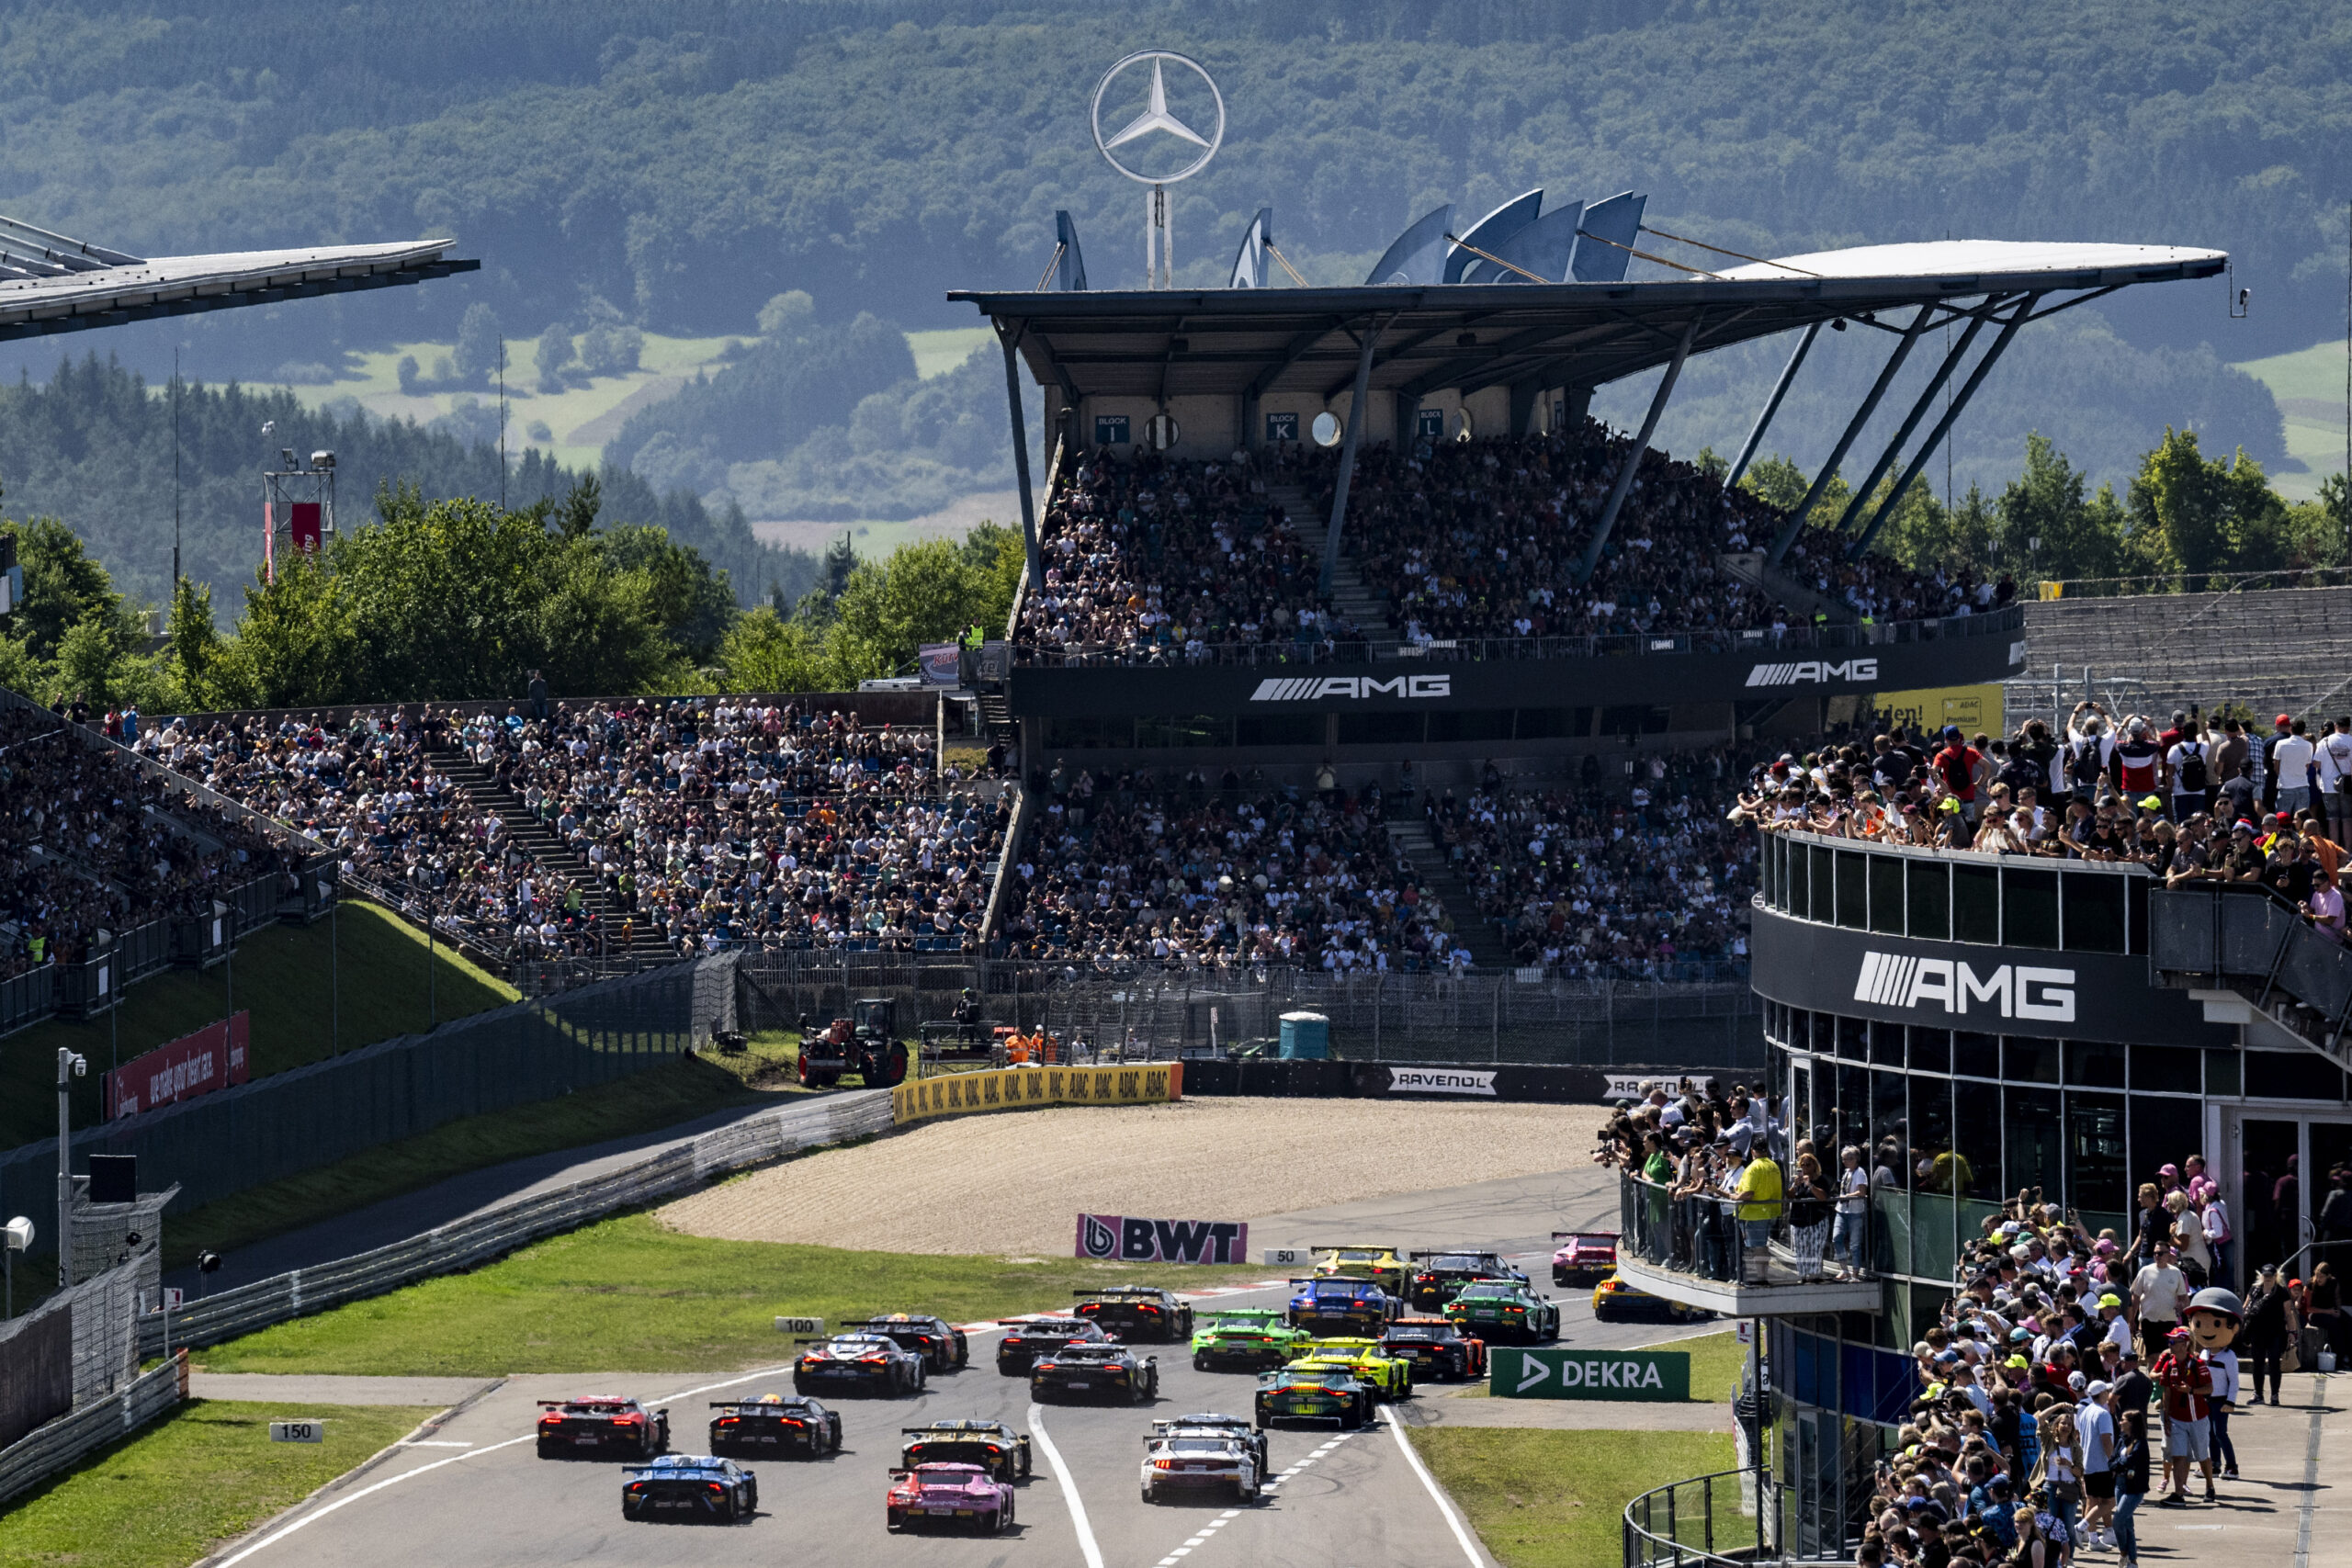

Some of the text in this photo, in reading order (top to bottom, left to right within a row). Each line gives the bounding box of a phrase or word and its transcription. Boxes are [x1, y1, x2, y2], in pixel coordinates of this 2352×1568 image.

[1098, 417, 1126, 425] BLOCK
[1270, 414, 1295, 423] BLOCK
[1275, 424, 1289, 439] K
[1427, 420, 1436, 434] L
[1787, 658, 1878, 684] AMG
[1317, 673, 1451, 699] AMG
[1960, 701, 1978, 709] ADAC
[1906, 958, 2075, 1022] AMG
[1145, 1071, 1168, 1098] ADAC
[1399, 1074, 1487, 1089] RAVENOL
[1614, 1081, 1704, 1094] RAENL
[1122, 1217, 1239, 1264] BWT
[1278, 1251, 1295, 1263] 50
[786, 1319, 814, 1333] 100
[1562, 1360, 1664, 1389] DEKRA
[281, 1424, 311, 1438] 150
